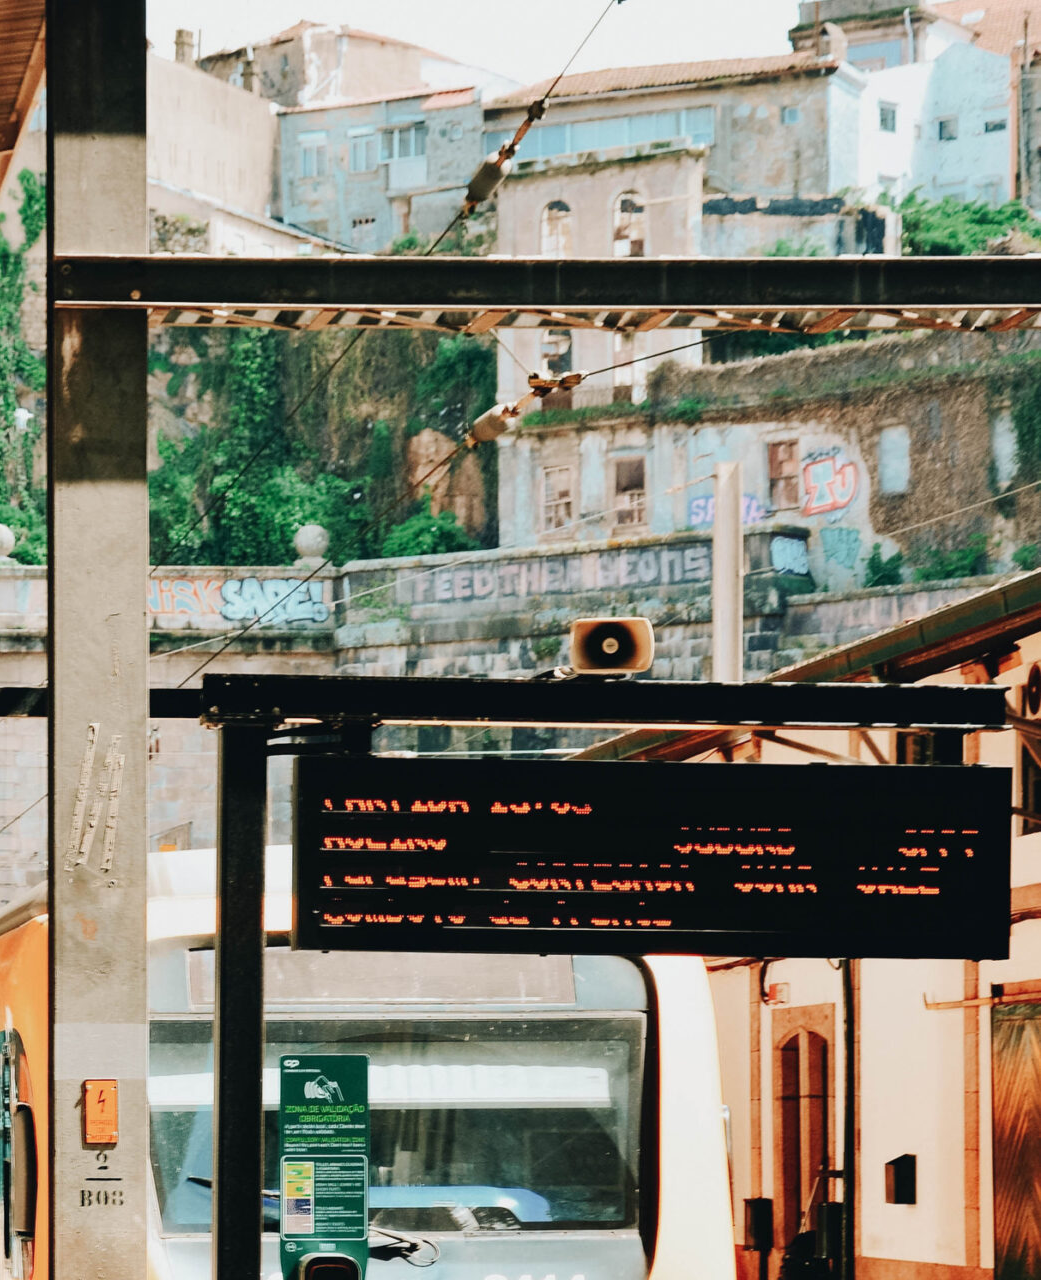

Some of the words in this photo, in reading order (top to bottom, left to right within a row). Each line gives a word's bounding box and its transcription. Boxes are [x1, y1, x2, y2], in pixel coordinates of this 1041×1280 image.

[285, 1105, 307, 1113] ZONA
[309, 1105, 320, 1113] DE
[321, 1104, 365, 1114] VALIDAÇÃO
[299, 1113, 351, 1123] OBRIGATÓRIA
[95, 1151, 109, 1170] 2
